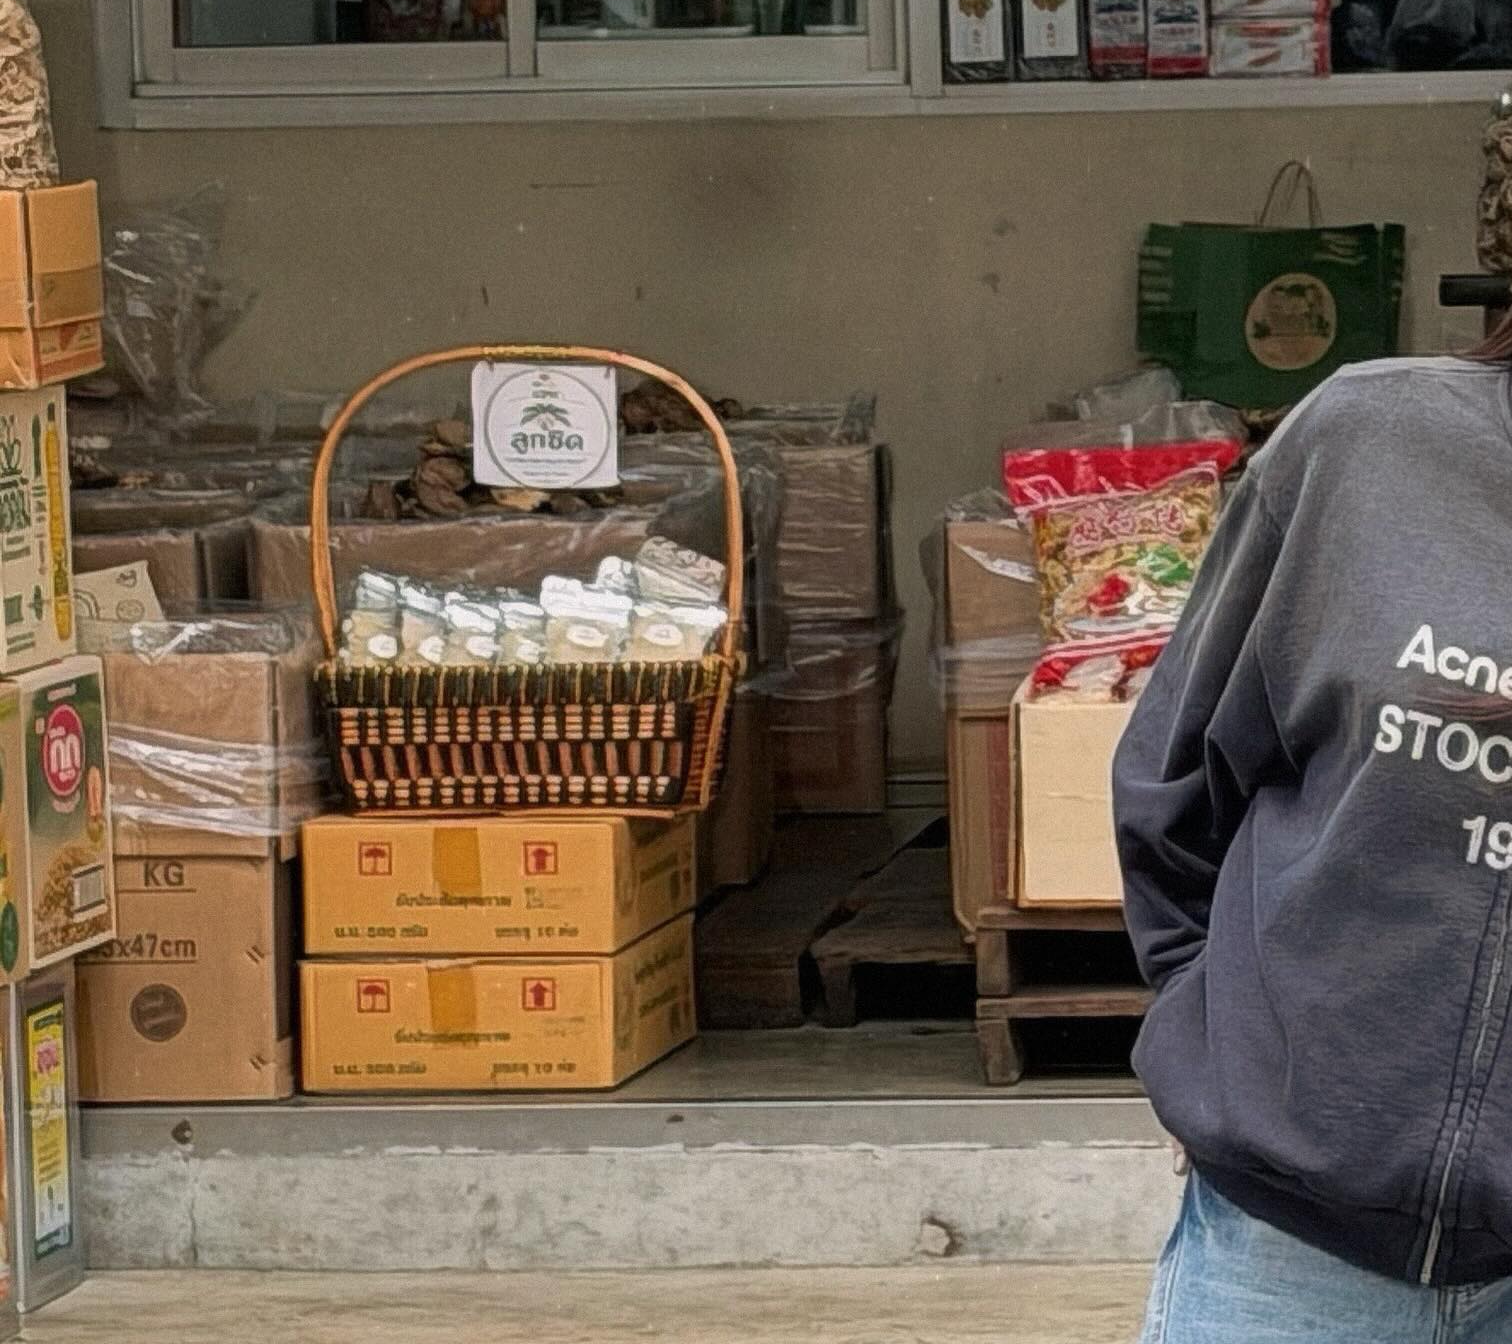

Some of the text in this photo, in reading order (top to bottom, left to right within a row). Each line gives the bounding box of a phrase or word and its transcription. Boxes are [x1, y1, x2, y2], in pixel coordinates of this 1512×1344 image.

[510, 429, 585, 455] ลูกชิด
[143, 861, 185, 887] KG
